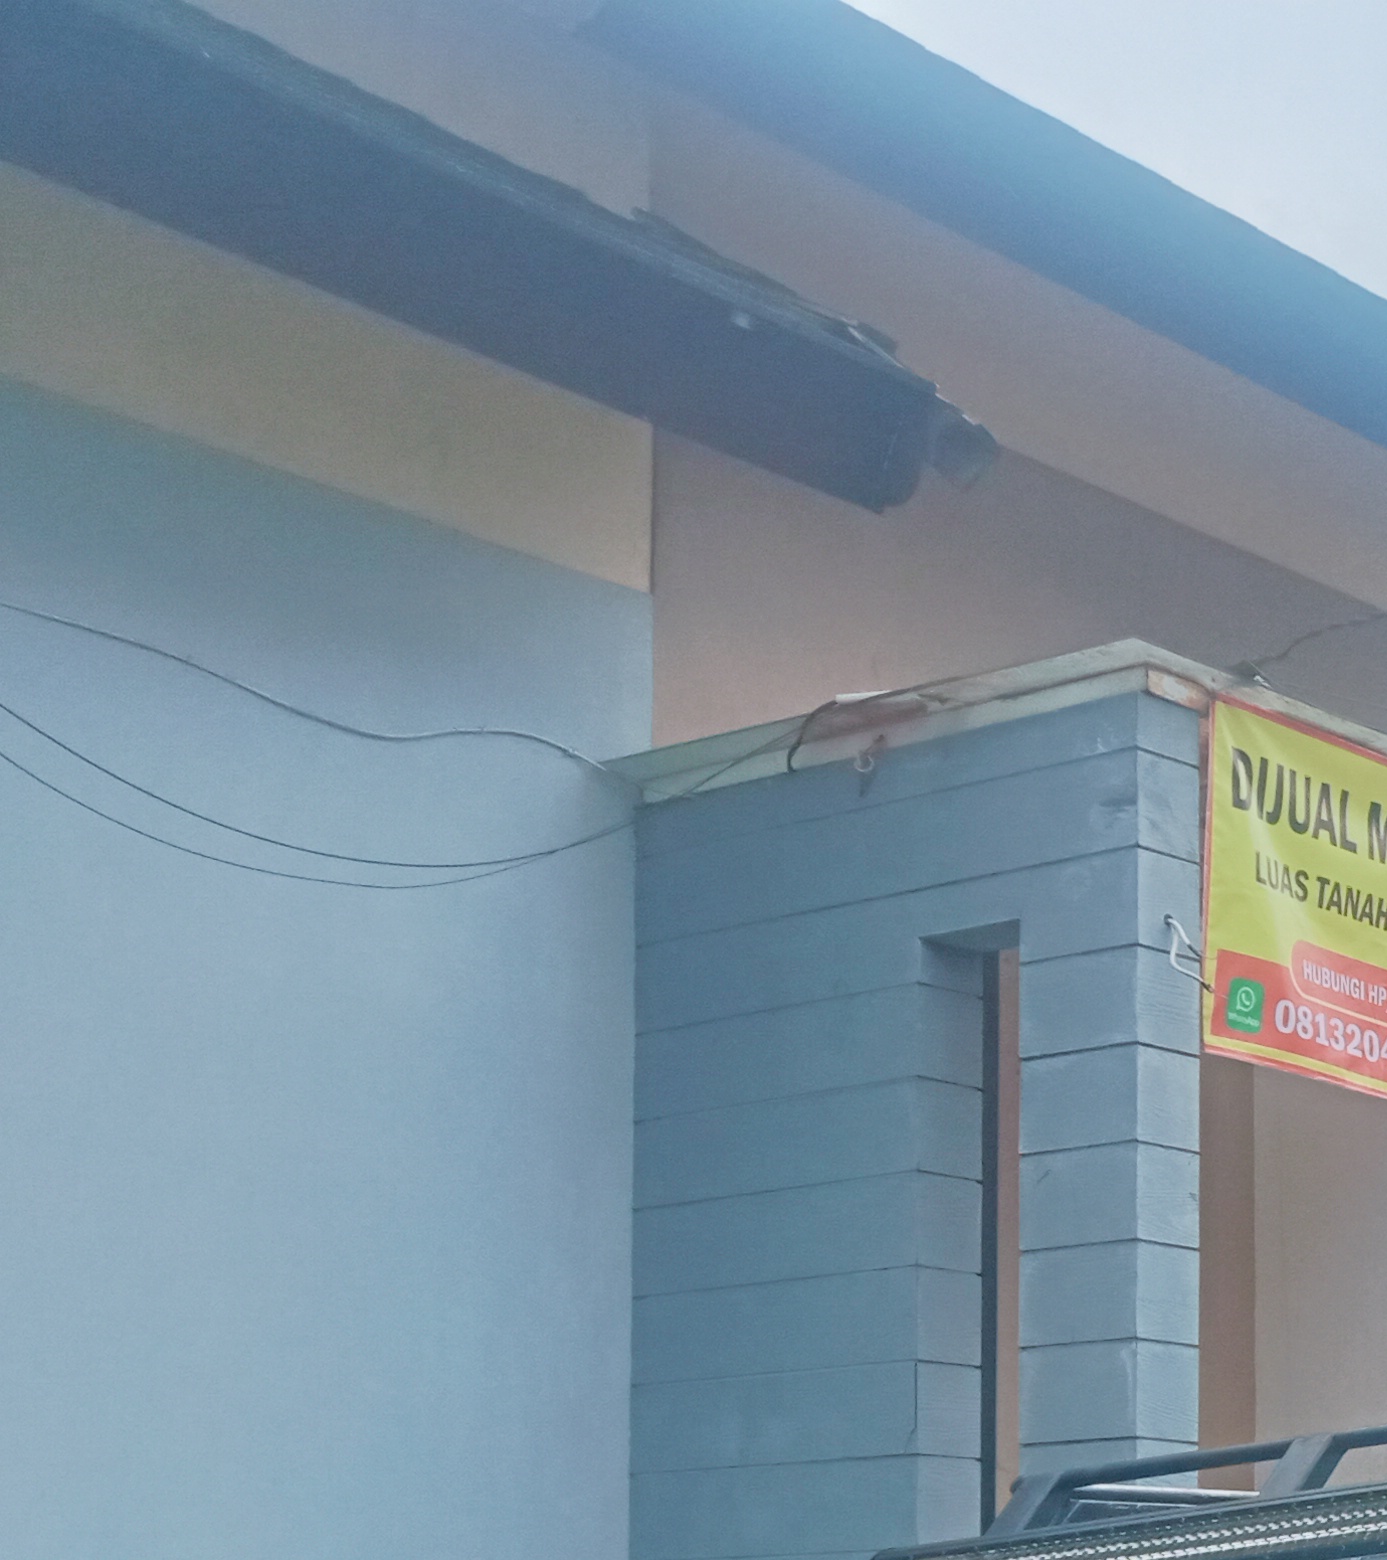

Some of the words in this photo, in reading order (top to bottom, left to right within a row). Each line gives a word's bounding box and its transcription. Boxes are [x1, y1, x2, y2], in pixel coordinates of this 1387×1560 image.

[1231, 745, 1358, 855] DIJUAL
[1255, 851, 1310, 902] LUAS
[1302, 959, 1366, 1001] HUBUNGI
